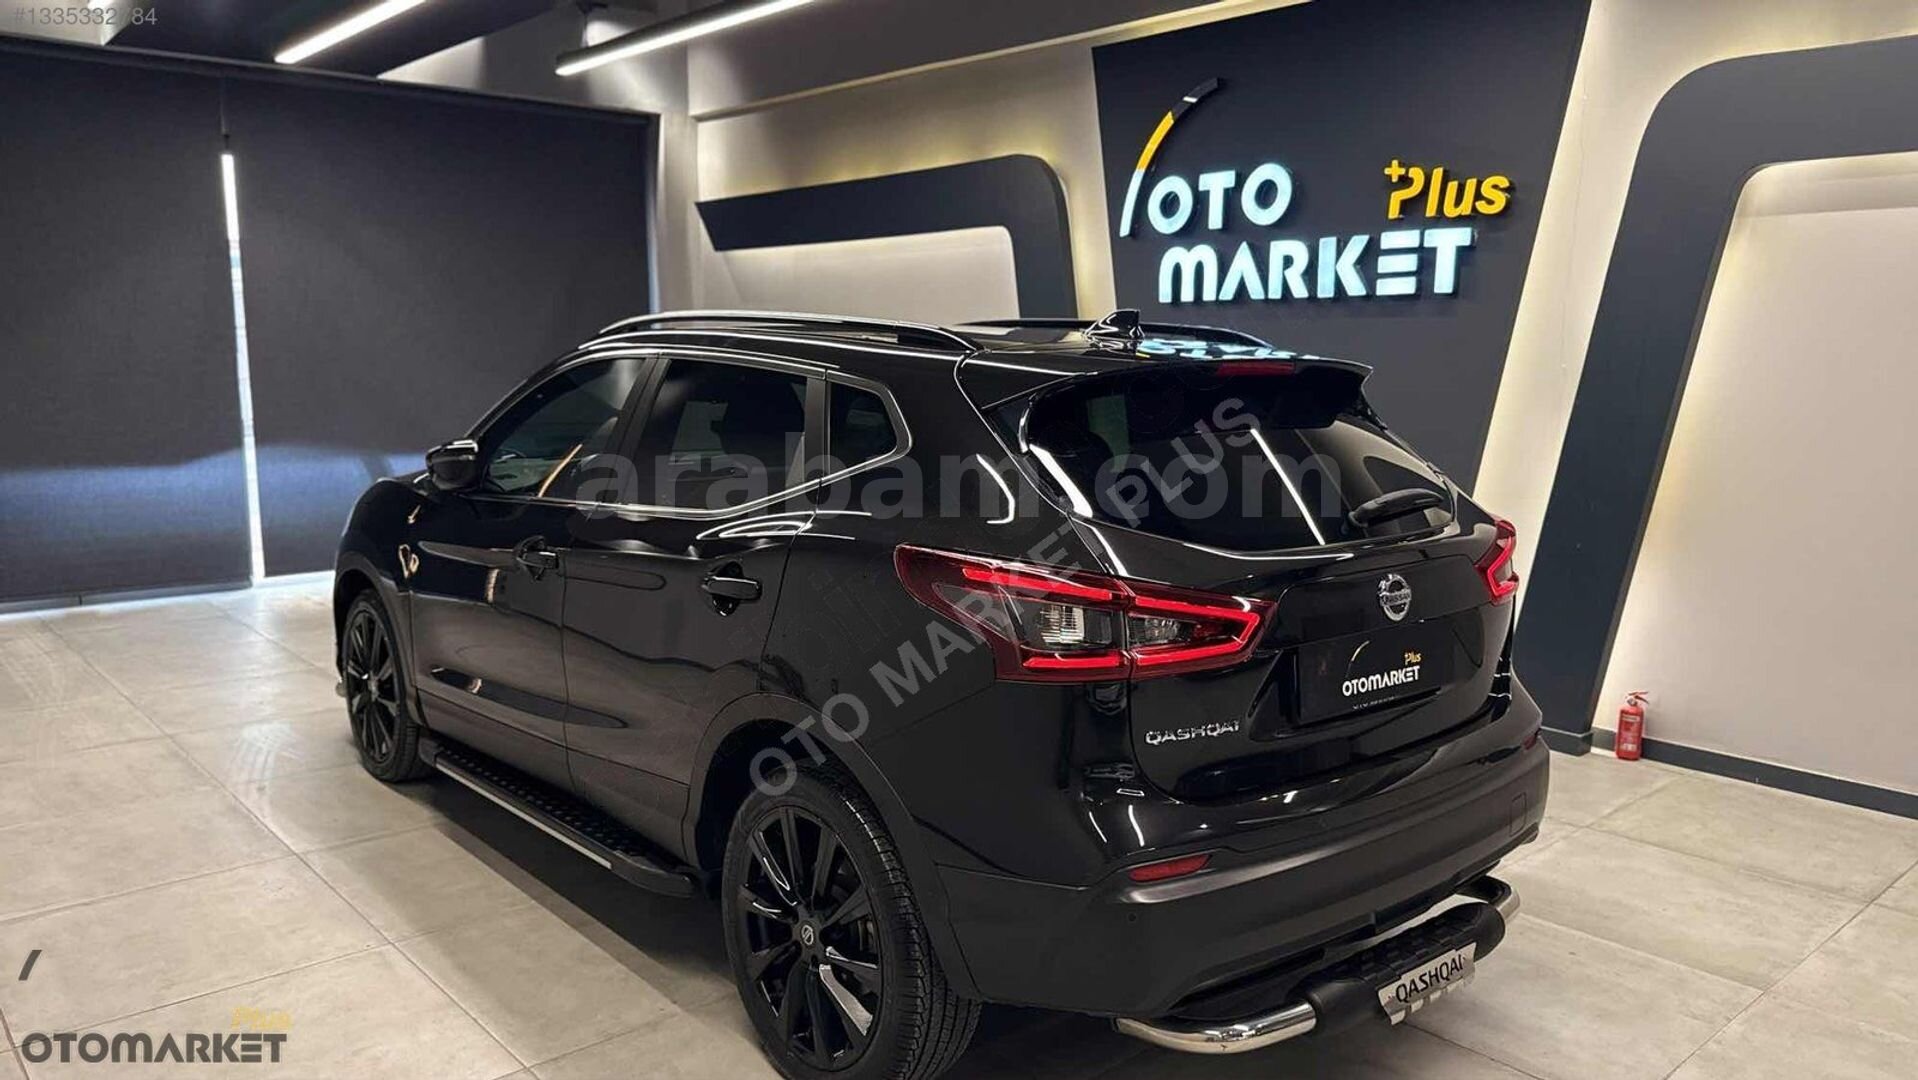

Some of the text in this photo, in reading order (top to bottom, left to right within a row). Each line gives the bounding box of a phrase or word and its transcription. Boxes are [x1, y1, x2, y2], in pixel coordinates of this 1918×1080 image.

[1147, 162, 1293, 235] OTO
[1158, 227, 1475, 303] MARKET
[1342, 665, 1420, 697] OTOMARKET
[1145, 720, 1239, 745] QASHQAI
[1395, 954, 1464, 1004] QASHQAI
